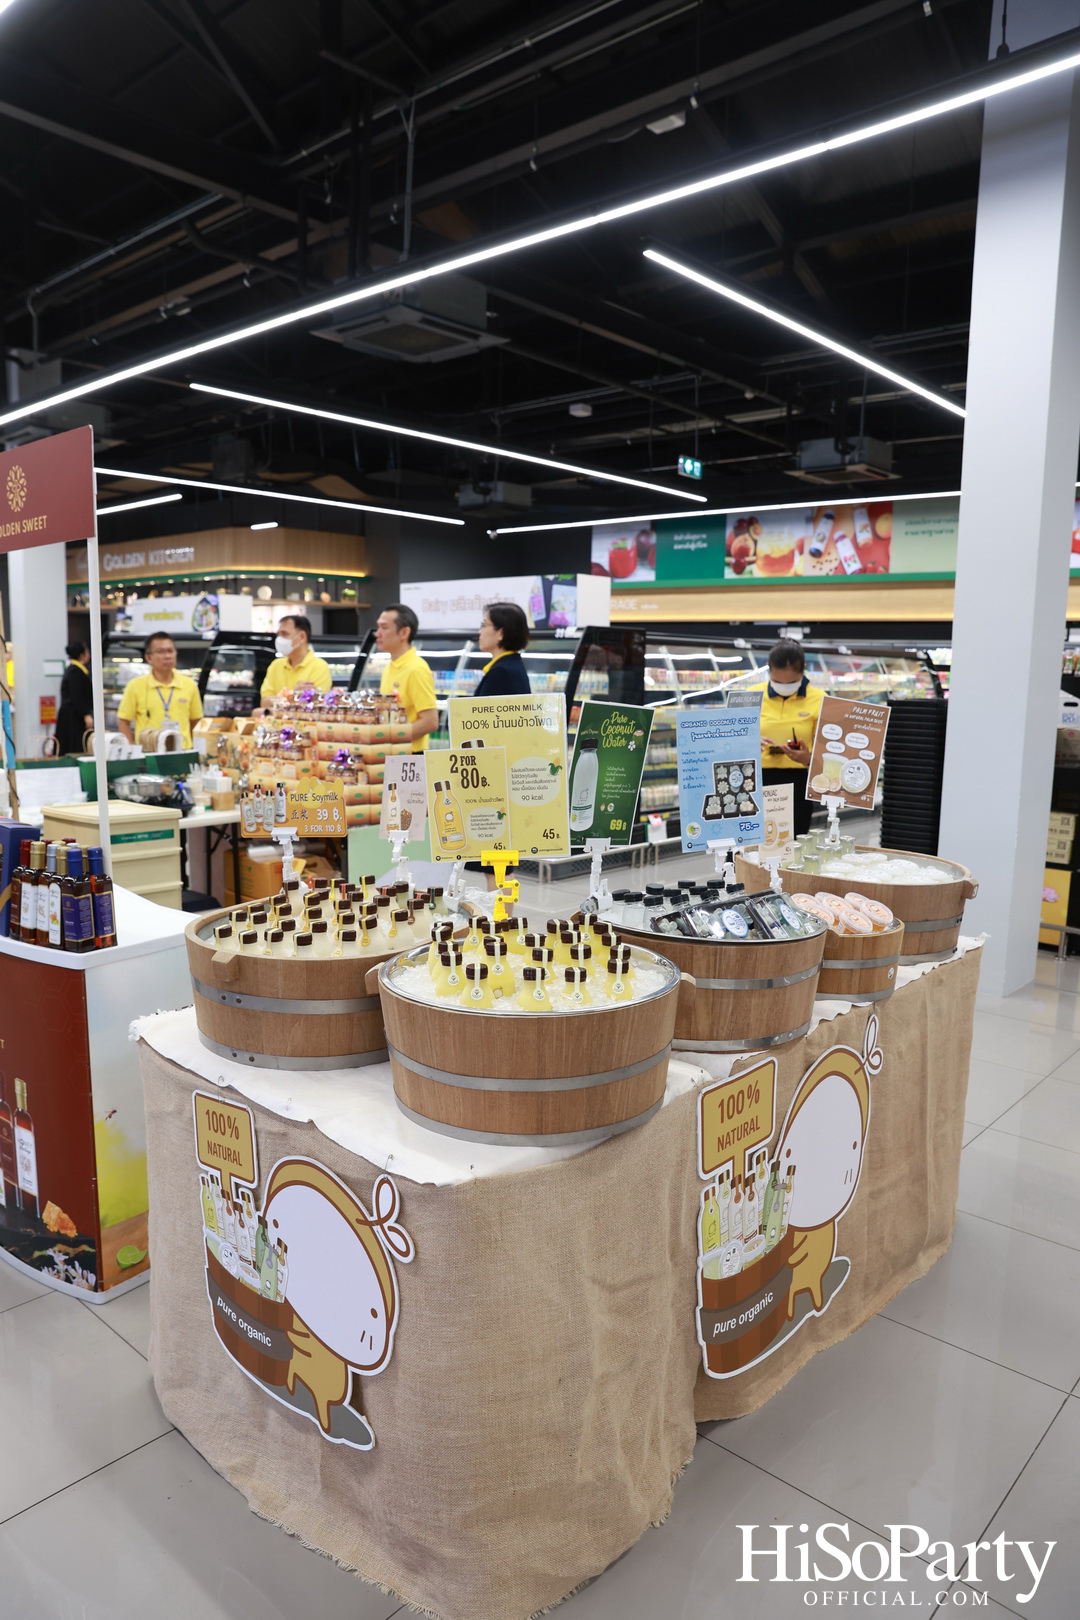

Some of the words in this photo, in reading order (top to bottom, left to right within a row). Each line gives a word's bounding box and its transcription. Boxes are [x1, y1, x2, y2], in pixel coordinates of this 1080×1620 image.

[22, 515, 48, 533] SWEET
[497, 705, 520, 713] CORN
[853, 706, 868, 714] PALM
[611, 711, 628, 724] Pure
[681, 720, 708, 728] ORGANIC
[709, 718, 737, 727] COCONUT
[738, 717, 758, 725] JELLY
[462, 719, 489, 730] 100%
[601, 719, 636, 736] Coconut
[602, 734, 627, 748] Water
[449, 754, 459, 773] 2
[460, 755, 477, 766] FOR
[290, 793, 308, 802] PURE
[312, 792, 338, 804] Soymilk
[316, 808, 328, 821] 39
[304, 824, 309, 832] 3
[542, 828, 555, 840] 45
[494, 842, 503, 850] 45
[717, 1080, 760, 1124] 100%
[206, 1109, 239, 1140] 100%
[717, 1115, 760, 1153] NATURAL
[207, 1140, 243, 1167] NATURAL
[217, 1296, 237, 1322] pure
[238, 1318, 272, 1347] organic
[712, 1318, 737, 1338] pure
[738, 1292, 774, 1325] organic
